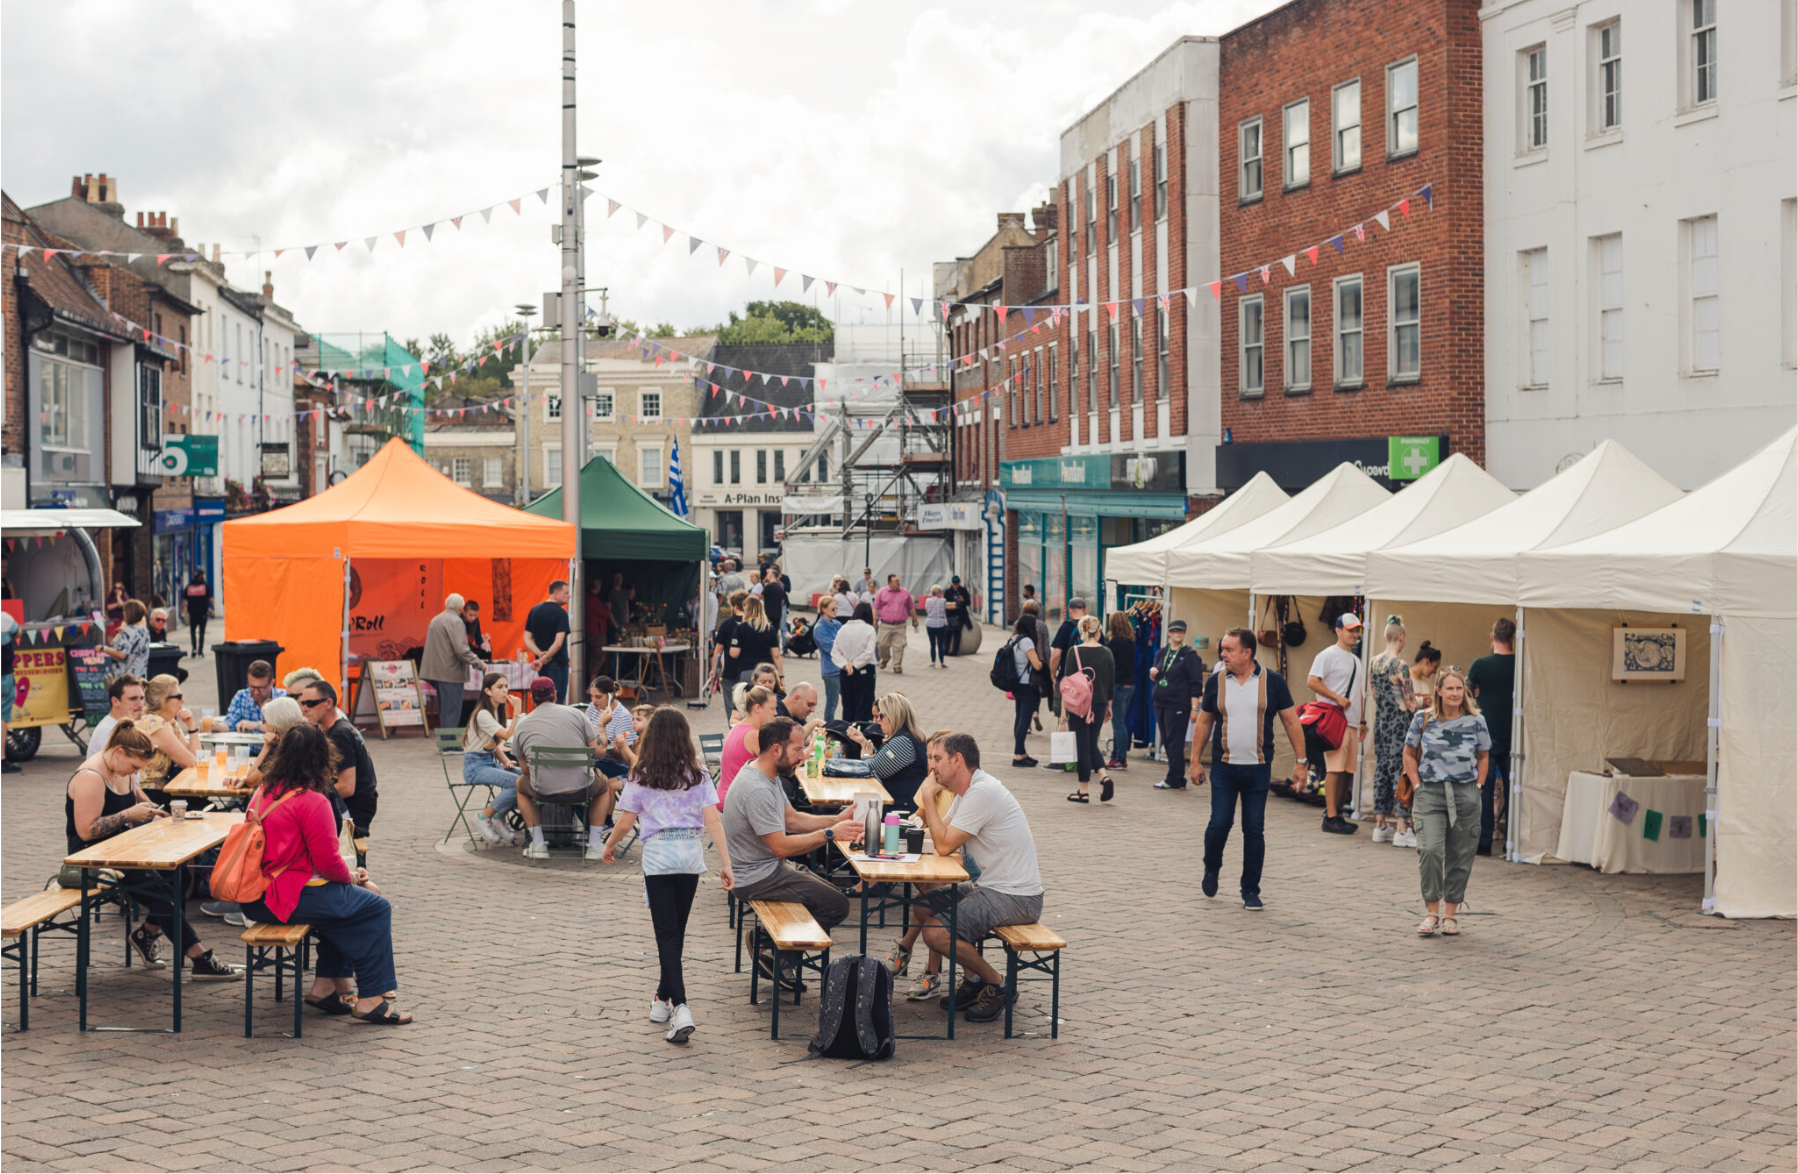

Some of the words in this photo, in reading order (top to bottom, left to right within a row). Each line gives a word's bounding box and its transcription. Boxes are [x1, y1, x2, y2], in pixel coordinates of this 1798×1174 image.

[1061, 459, 1086, 483] Poundland
[724, 493, 761, 504] A-Plan
[764, 493, 783, 504] Ins
[13, 651, 64, 668] PPERS
